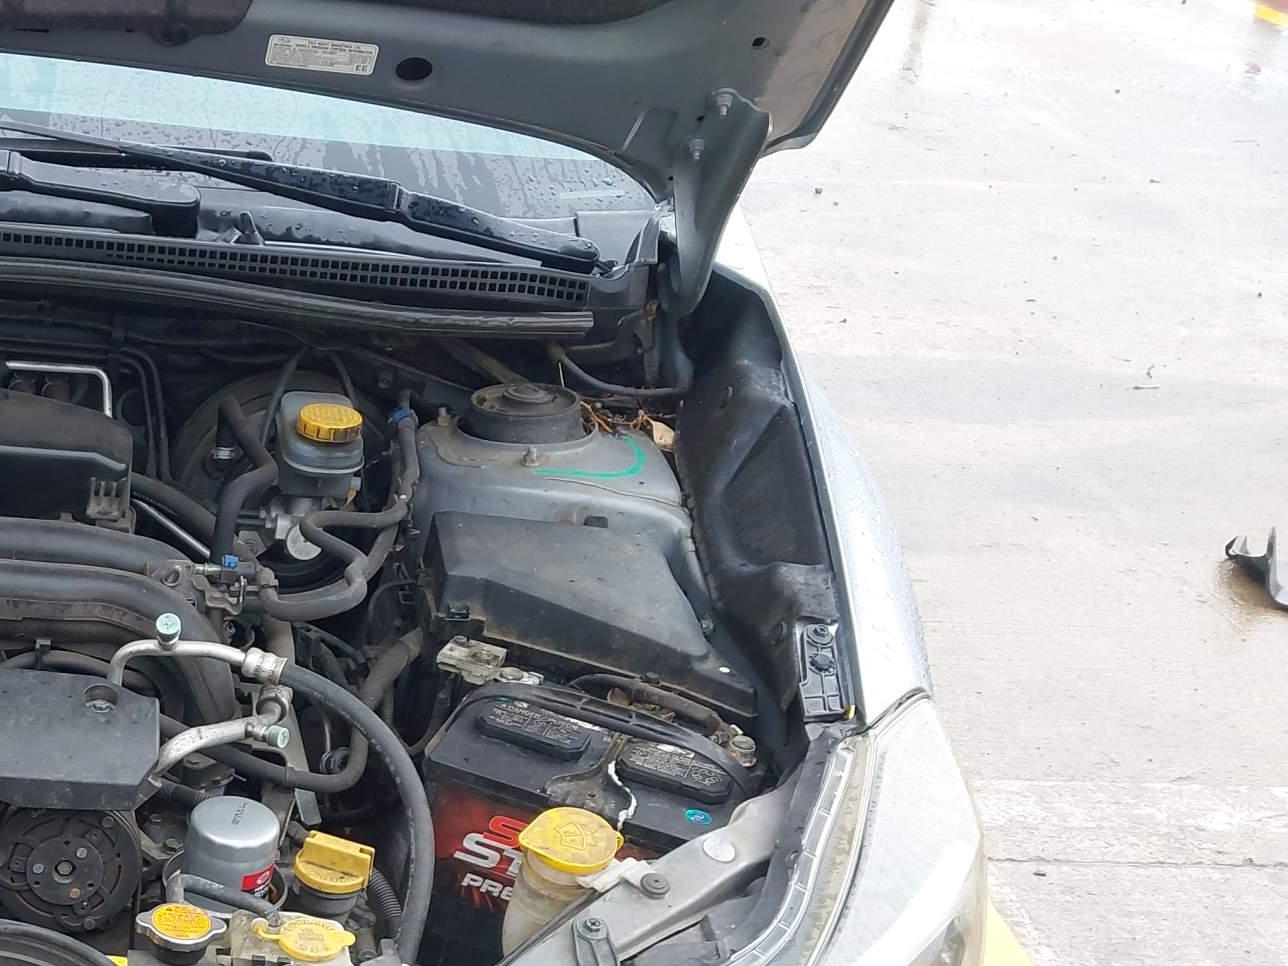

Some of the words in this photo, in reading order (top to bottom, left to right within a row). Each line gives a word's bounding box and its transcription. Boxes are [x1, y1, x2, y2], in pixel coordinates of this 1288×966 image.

[482, 815, 529, 849] S
[453, 832, 524, 878] ST
[461, 872, 514, 901] PRE
